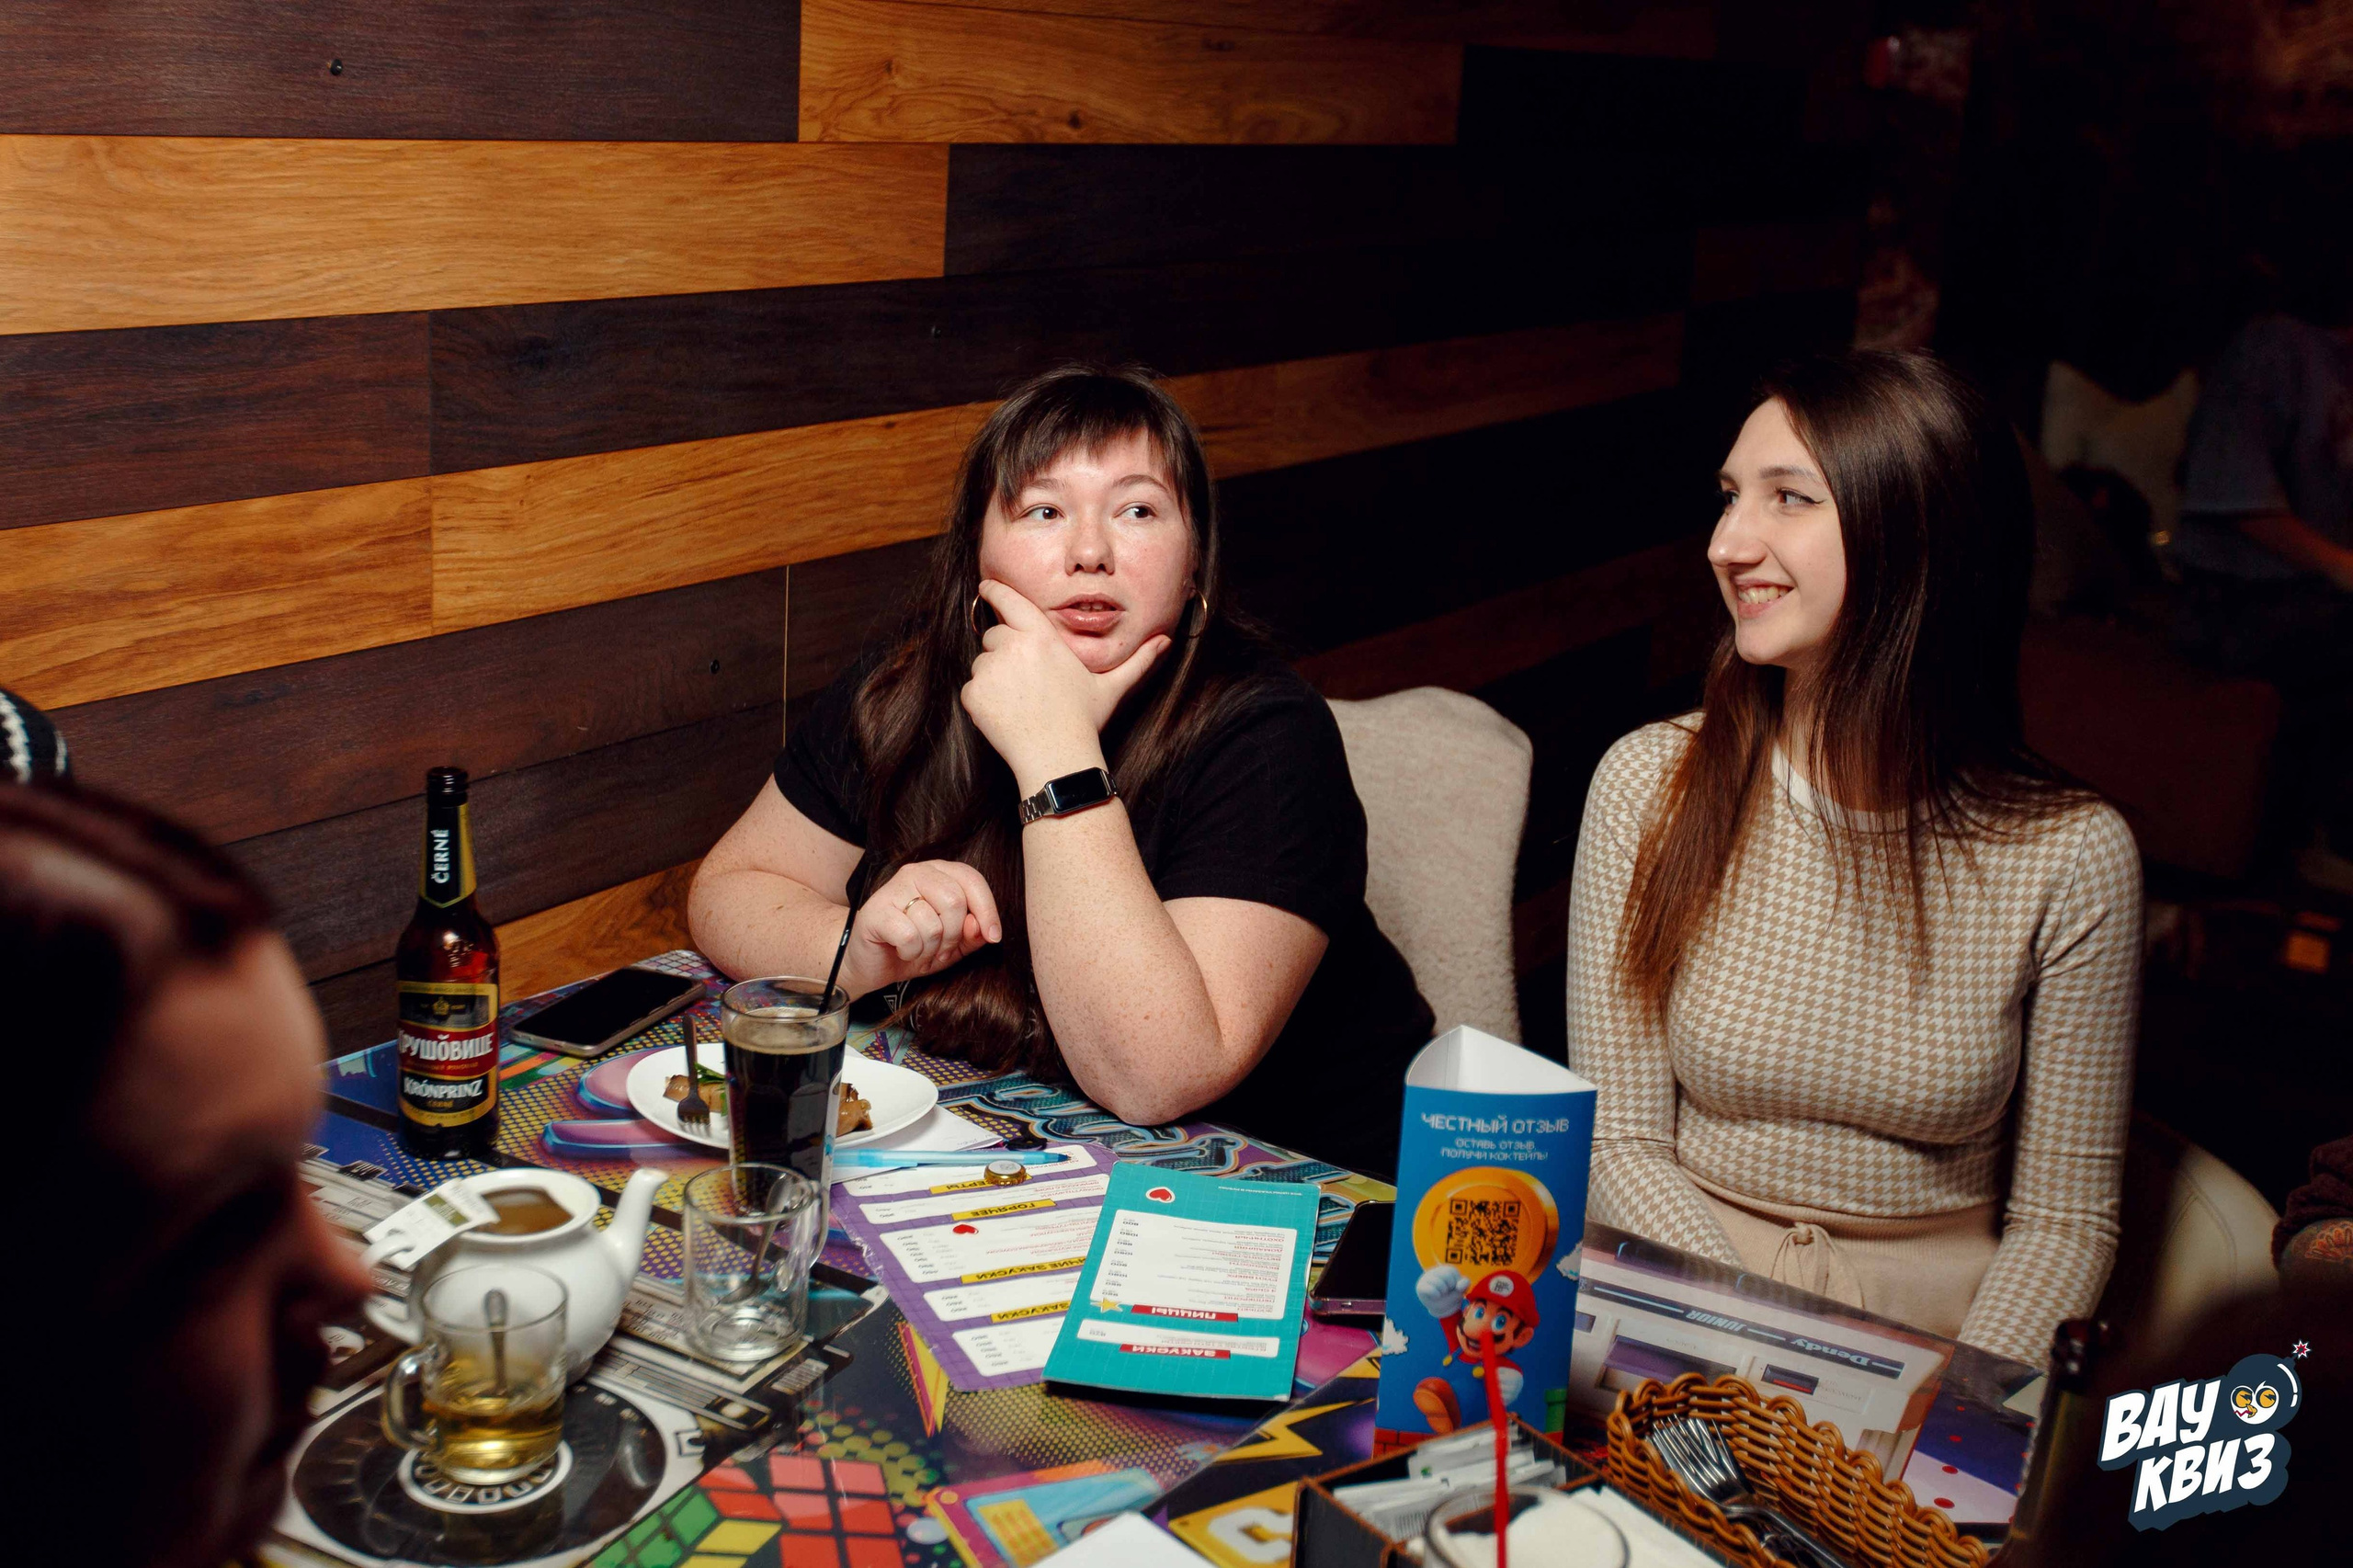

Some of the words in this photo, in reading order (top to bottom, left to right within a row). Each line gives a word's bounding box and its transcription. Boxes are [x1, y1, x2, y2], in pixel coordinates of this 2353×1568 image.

[430, 828, 449, 884] ČERNÉ
[1421, 1112, 1508, 1134] ЧЕСТНЫЙ
[1512, 1118, 1570, 1133] ОТЗЫВ
[1455, 1137, 1497, 1150] ОСТАВЬ
[1440, 1147, 1487, 1161] ПОЛУЧИ
[1489, 1150, 1549, 1161] КОКТЕЙЛЬ!
[947, 1181, 986, 1189] ЕРТЫ
[971, 1202, 1036, 1217] ГОРЯЧЕЕ
[976, 1266, 1047, 1279] ЗАКУСКИ
[998, 1303, 1070, 1320] ЗАКУСКИ
[1152, 1306, 1216, 1320] ПИЦЦЫ
[1686, 1309, 1747, 1332] JUNIOR
[1132, 1345, 1216, 1358] ЗАКУСКИ
[1793, 1337, 1870, 1367] Dendy
